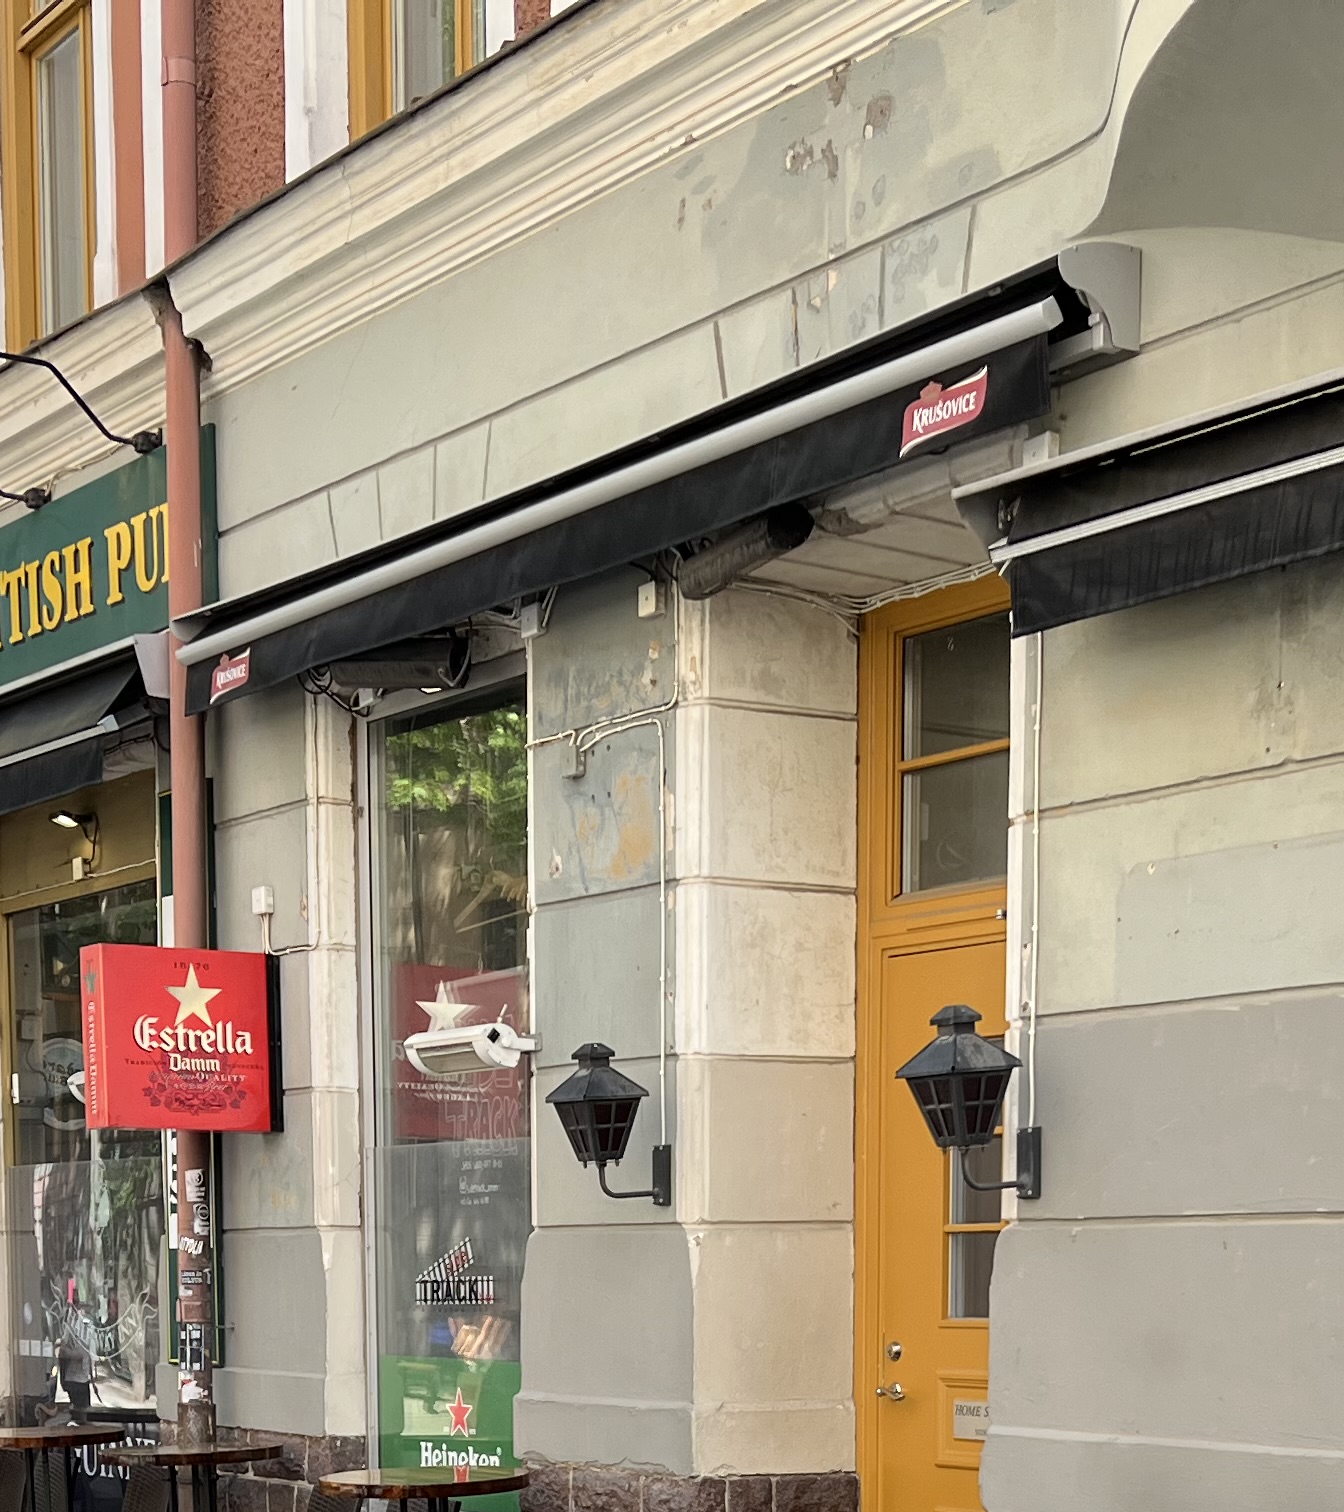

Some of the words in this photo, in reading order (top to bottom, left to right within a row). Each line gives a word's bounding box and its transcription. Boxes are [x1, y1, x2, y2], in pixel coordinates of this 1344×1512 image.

[912, 391, 977, 433] KRUŠOVICE
[133, 1014, 254, 1055] Estrella
[168, 1053, 221, 1072] Damm
[420, 1279, 479, 1303] TRACK
[954, 1404, 981, 1417] HOME
[420, 1442, 500, 1468] Heineken
